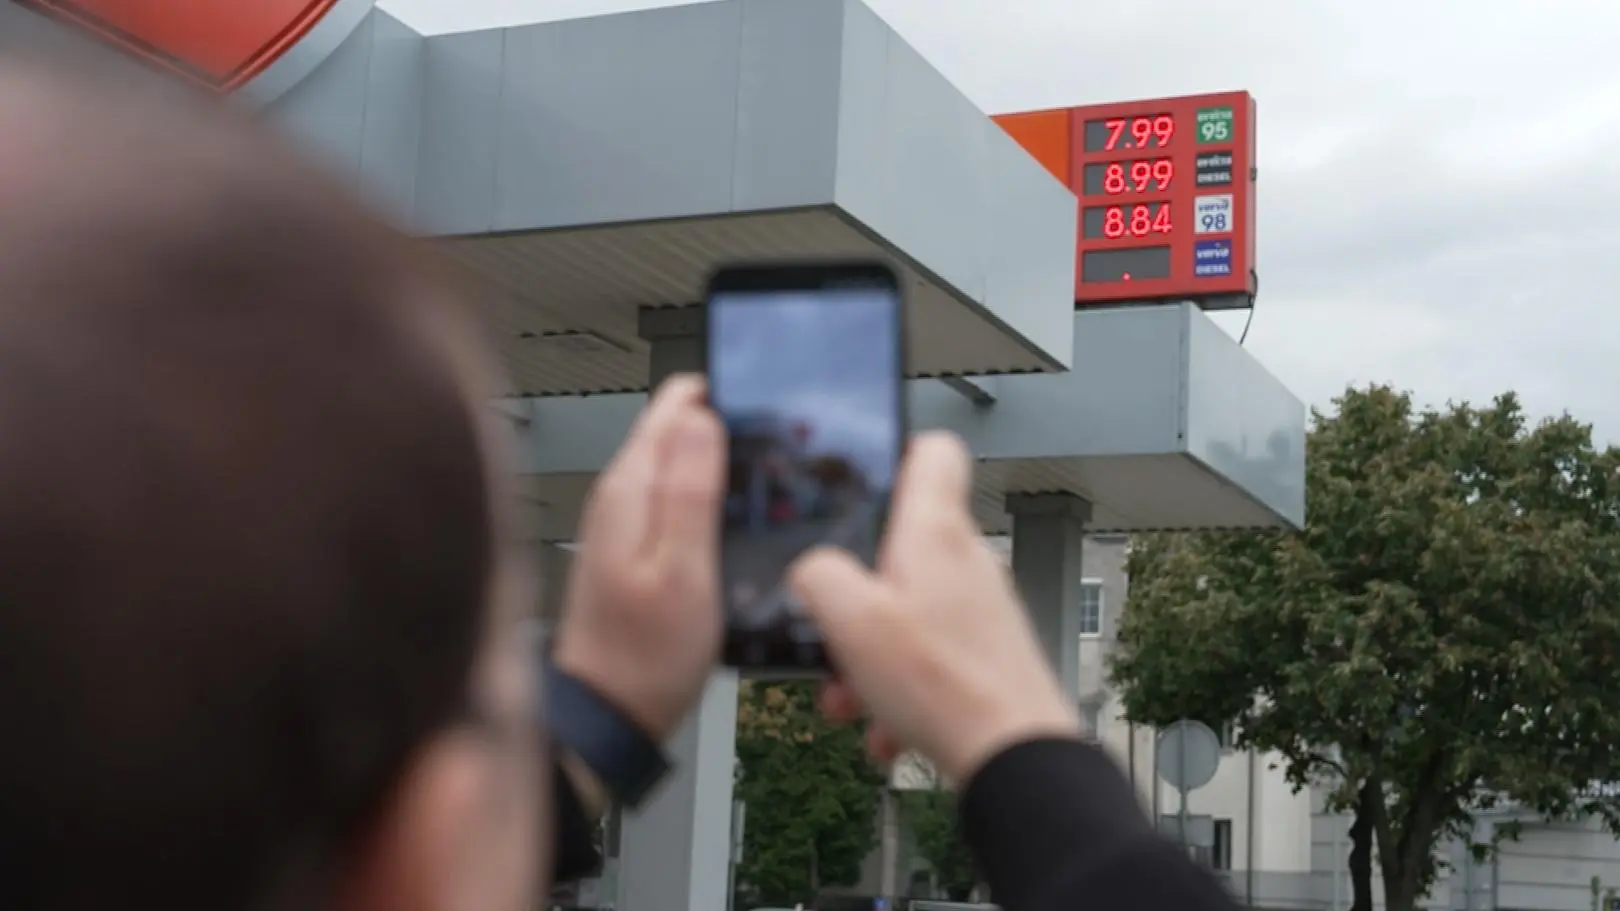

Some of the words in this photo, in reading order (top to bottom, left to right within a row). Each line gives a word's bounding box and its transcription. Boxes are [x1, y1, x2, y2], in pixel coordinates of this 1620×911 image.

[1104, 116, 1173, 150] 7.99
[1202, 121, 1228, 141] 95
[1104, 159, 1172, 193] 8.99
[1104, 203, 1172, 237] 8.84
[1202, 213, 1226, 232] 98
